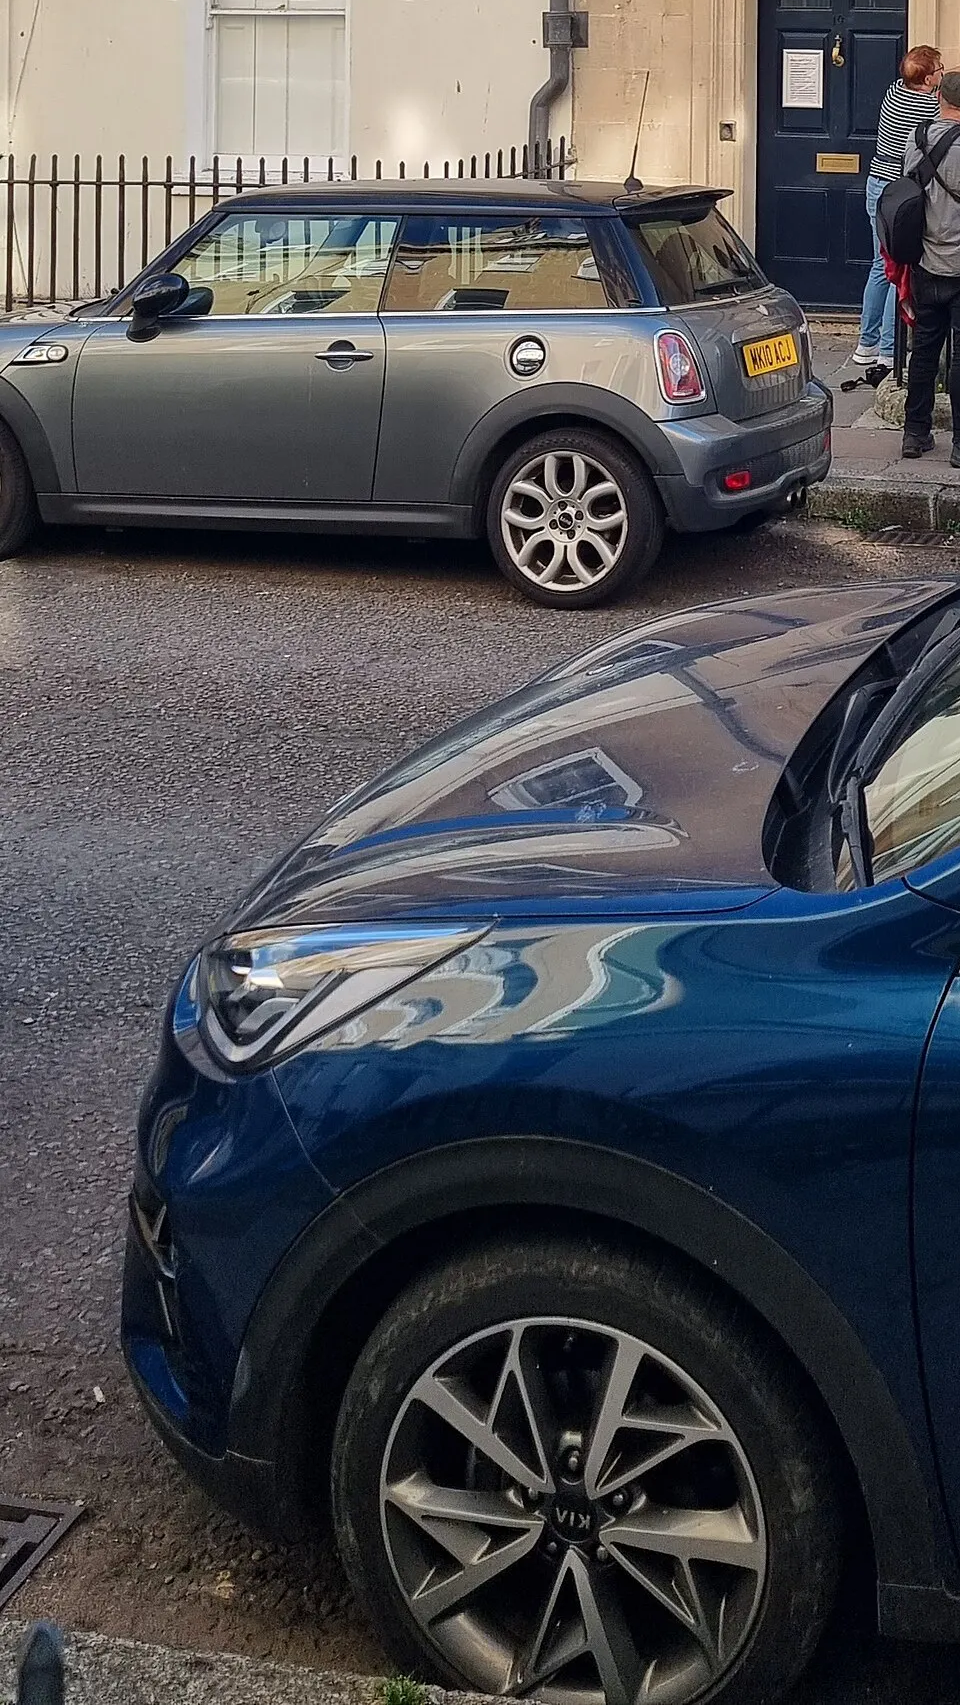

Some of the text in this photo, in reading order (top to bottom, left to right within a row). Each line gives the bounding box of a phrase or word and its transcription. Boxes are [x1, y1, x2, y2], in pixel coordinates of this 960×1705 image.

[749, 339, 792, 371] MK10 ACJ
[556, 1507, 591, 1529] KIA
